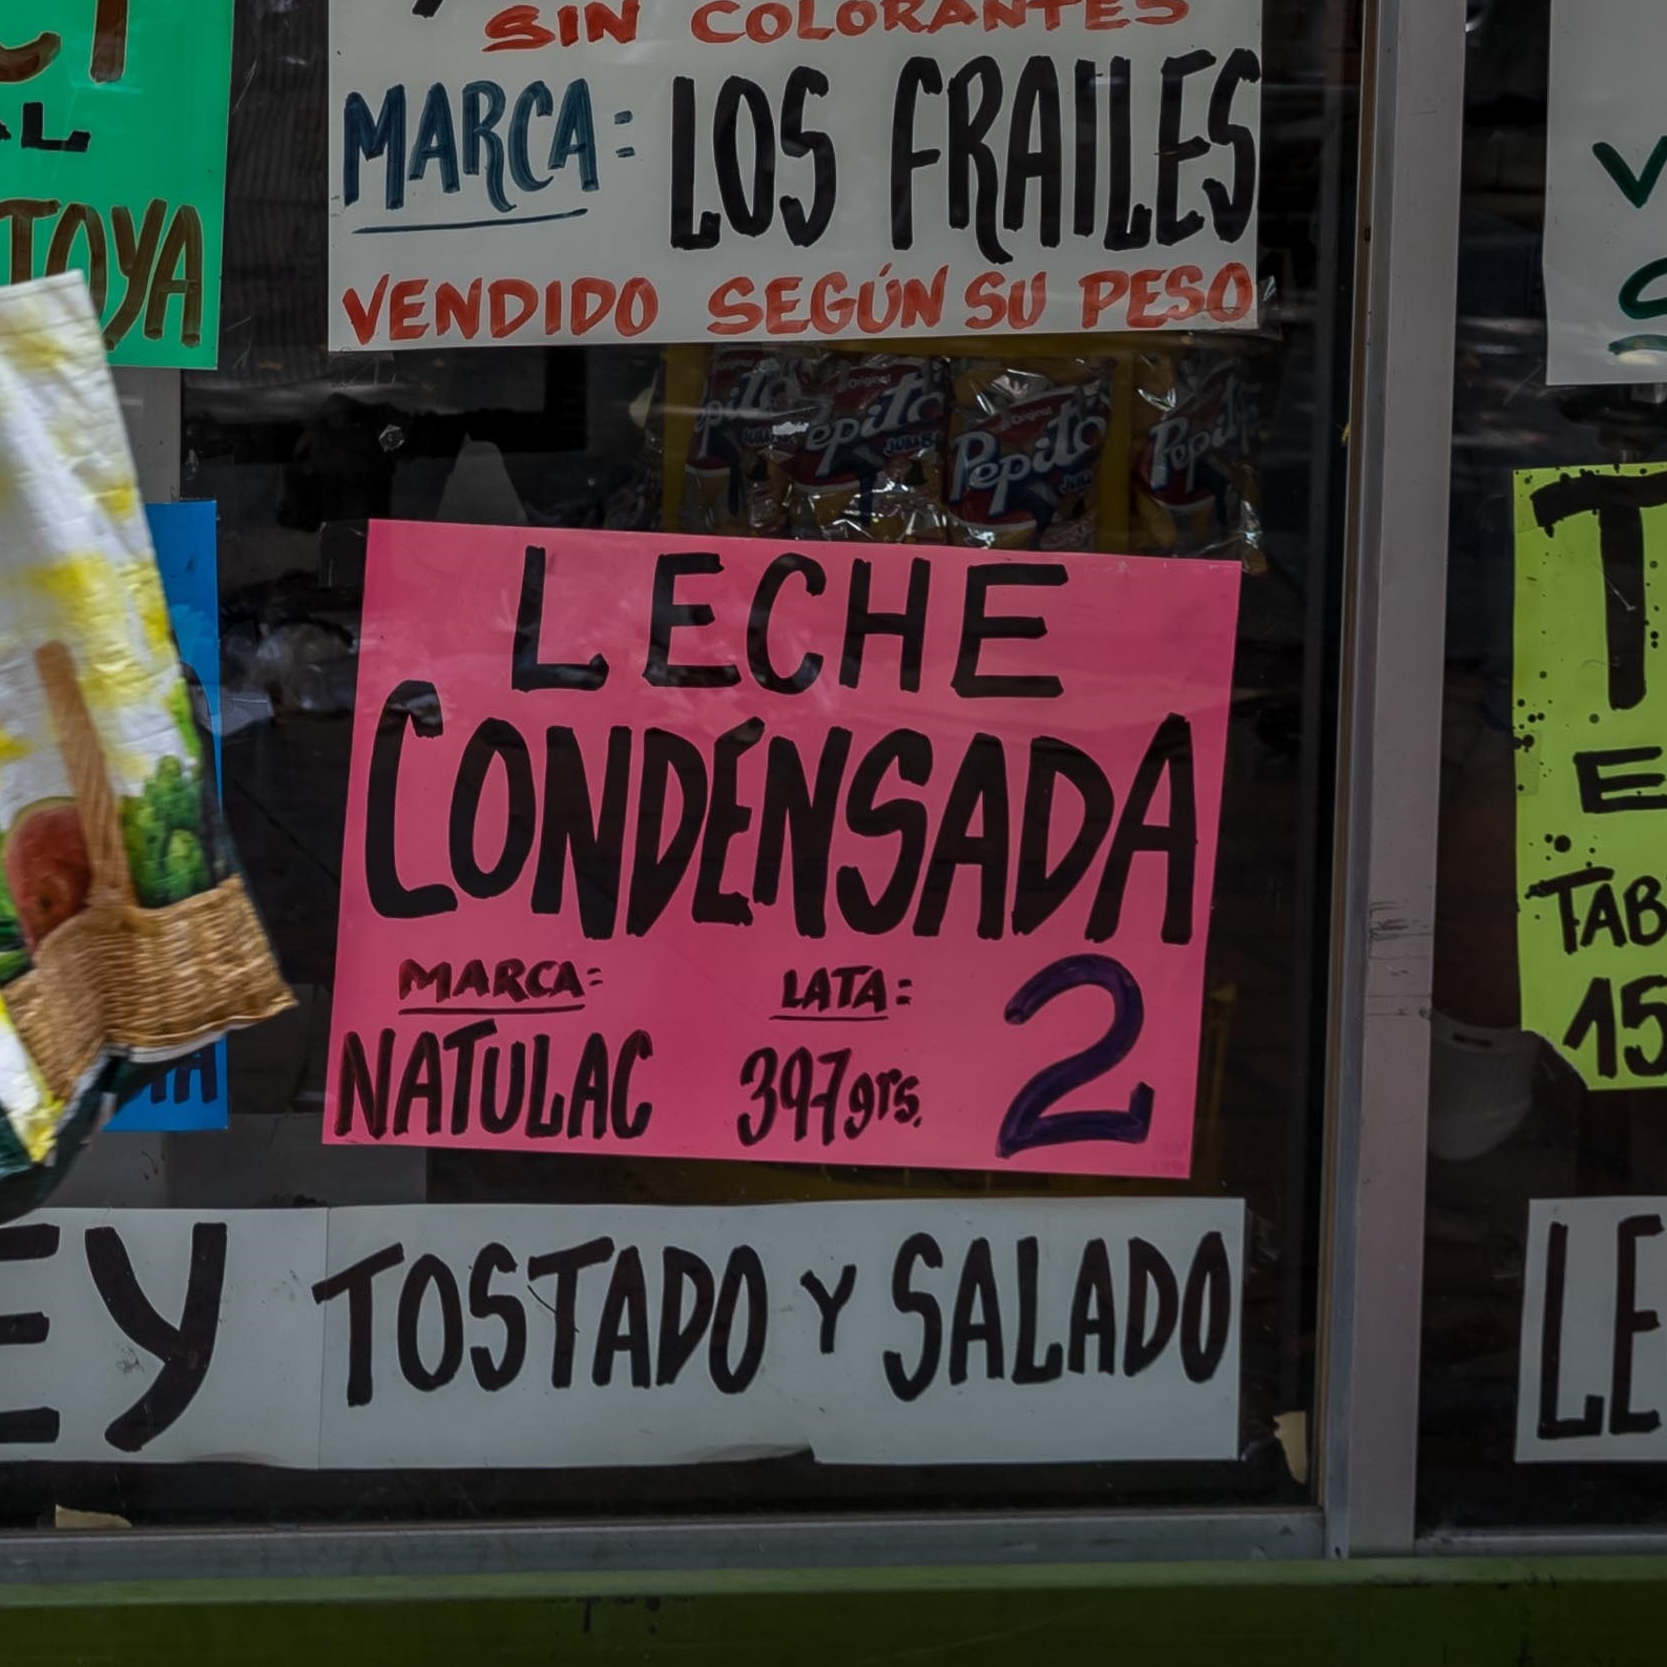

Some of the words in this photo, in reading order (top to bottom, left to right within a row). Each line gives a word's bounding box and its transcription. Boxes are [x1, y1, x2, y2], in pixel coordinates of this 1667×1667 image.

[343, 78, 635, 213] MARCA:
[670, 65, 837, 251] LOS
[891, 48, 1263, 264] FRAILES
[342, 274, 658, 345] VENDIDO
[707, 264, 949, 335] SEGÚN
[965, 271, 1046, 329] SU
[1079, 262, 1253, 329] PESO
[946, 395, 1108, 517] Pepito
[1146, 373, 1260, 495] Pepit
[511, 545, 1069, 699] LECHE
[365, 679, 1198, 946] CONDENSADA
[335, 1018, 653, 1140] NATULAC
[399, 958, 603, 1003] MARCA:
[782, 965, 912, 1013] LATA:
[997, 953, 1155, 1159] 2
[311, 1236, 768, 1408] TOSTADO
[800, 1264, 857, 1355] Y
[882, 1231, 1231, 1402] SALADO
